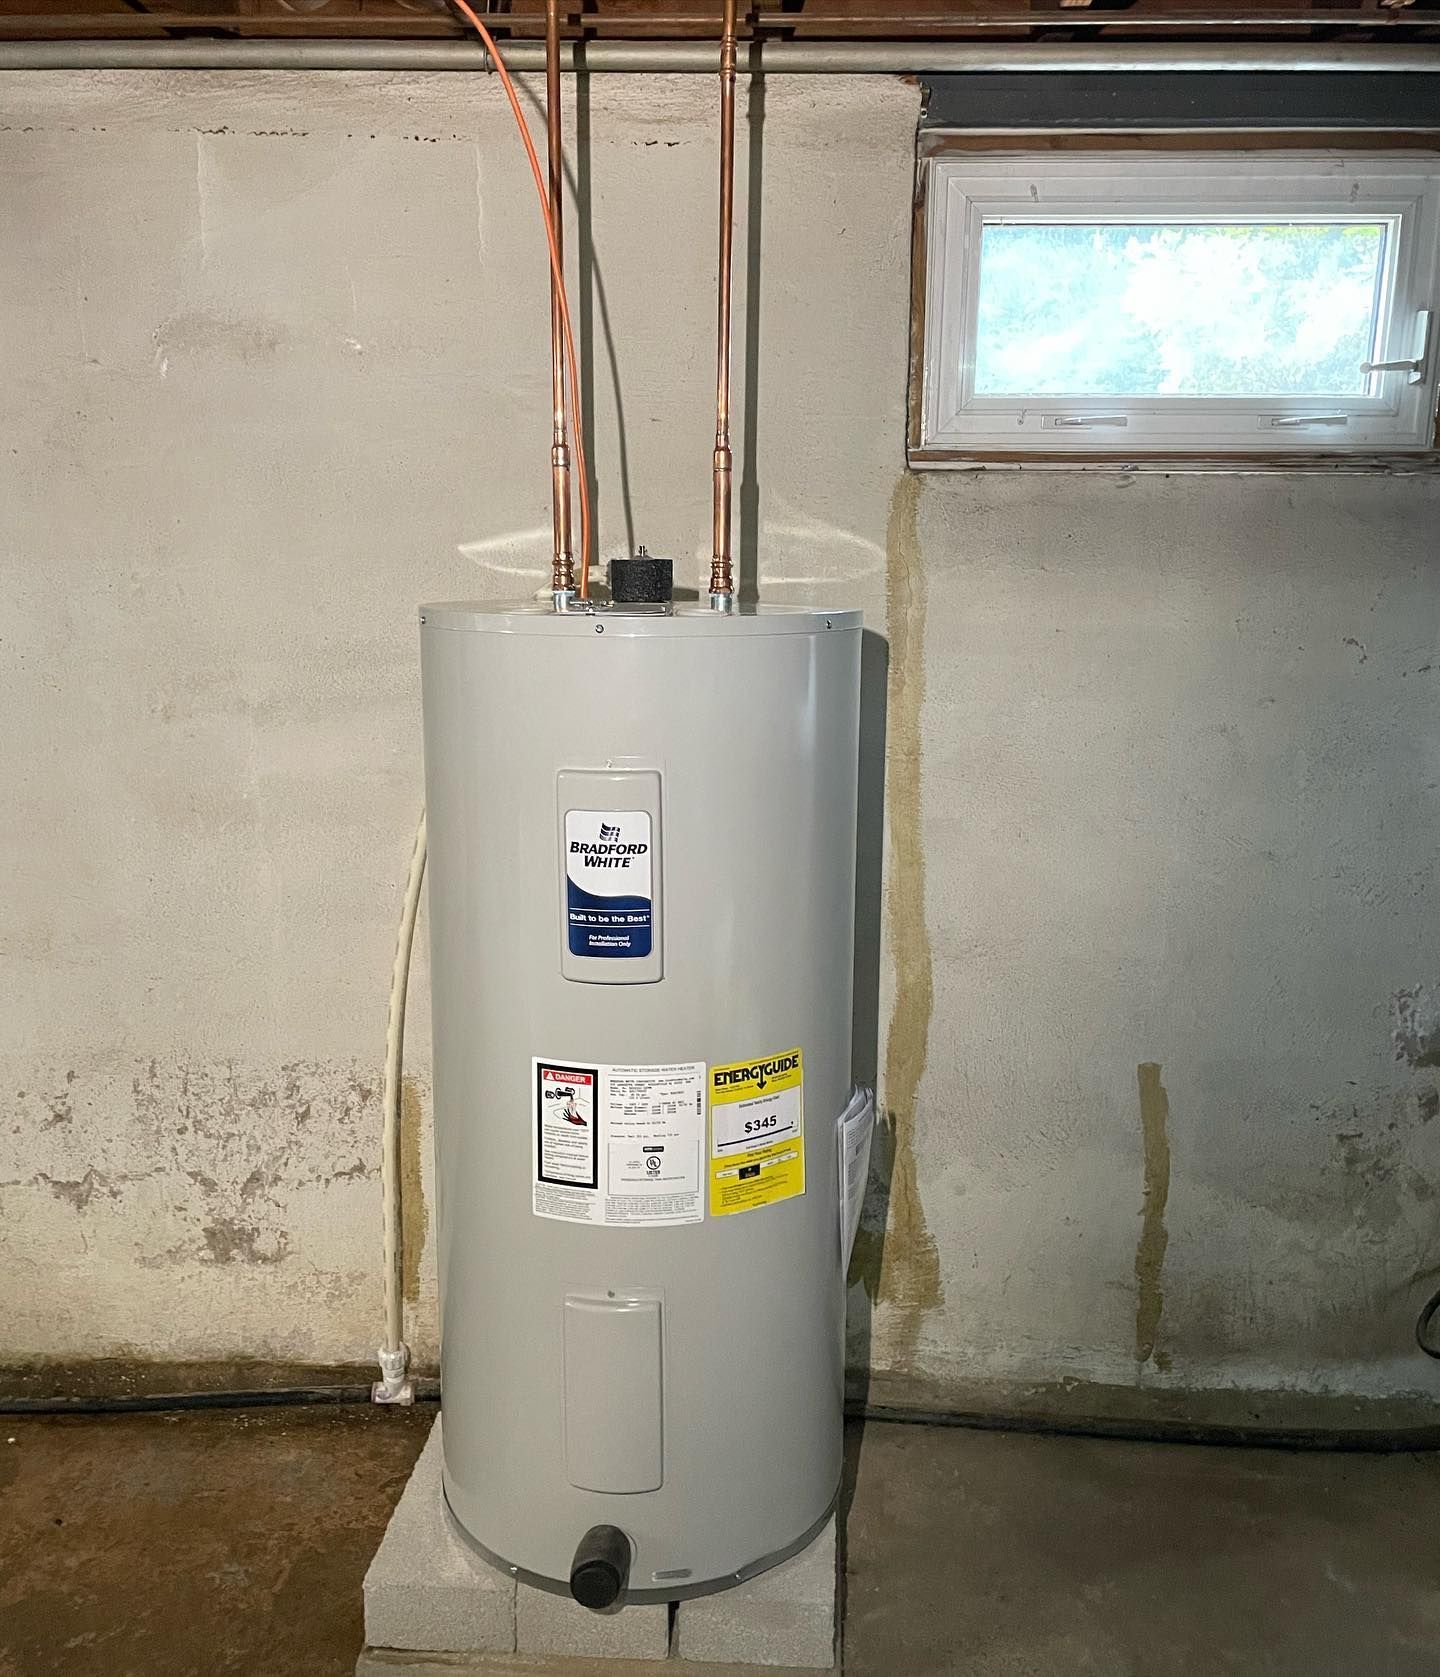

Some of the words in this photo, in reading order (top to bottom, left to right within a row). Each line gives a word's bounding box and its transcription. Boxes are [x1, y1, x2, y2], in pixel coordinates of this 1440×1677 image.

[570, 841, 648, 855] BRADFORD
[584, 855, 631, 868] WHITE
[569, 913, 587, 922] Built
[588, 914, 597, 922] to
[714, 1054, 799, 1087] ENERGYGUIDE
[555, 1073, 586, 1084] DANGER
[744, 1115, 777, 1134] $345
